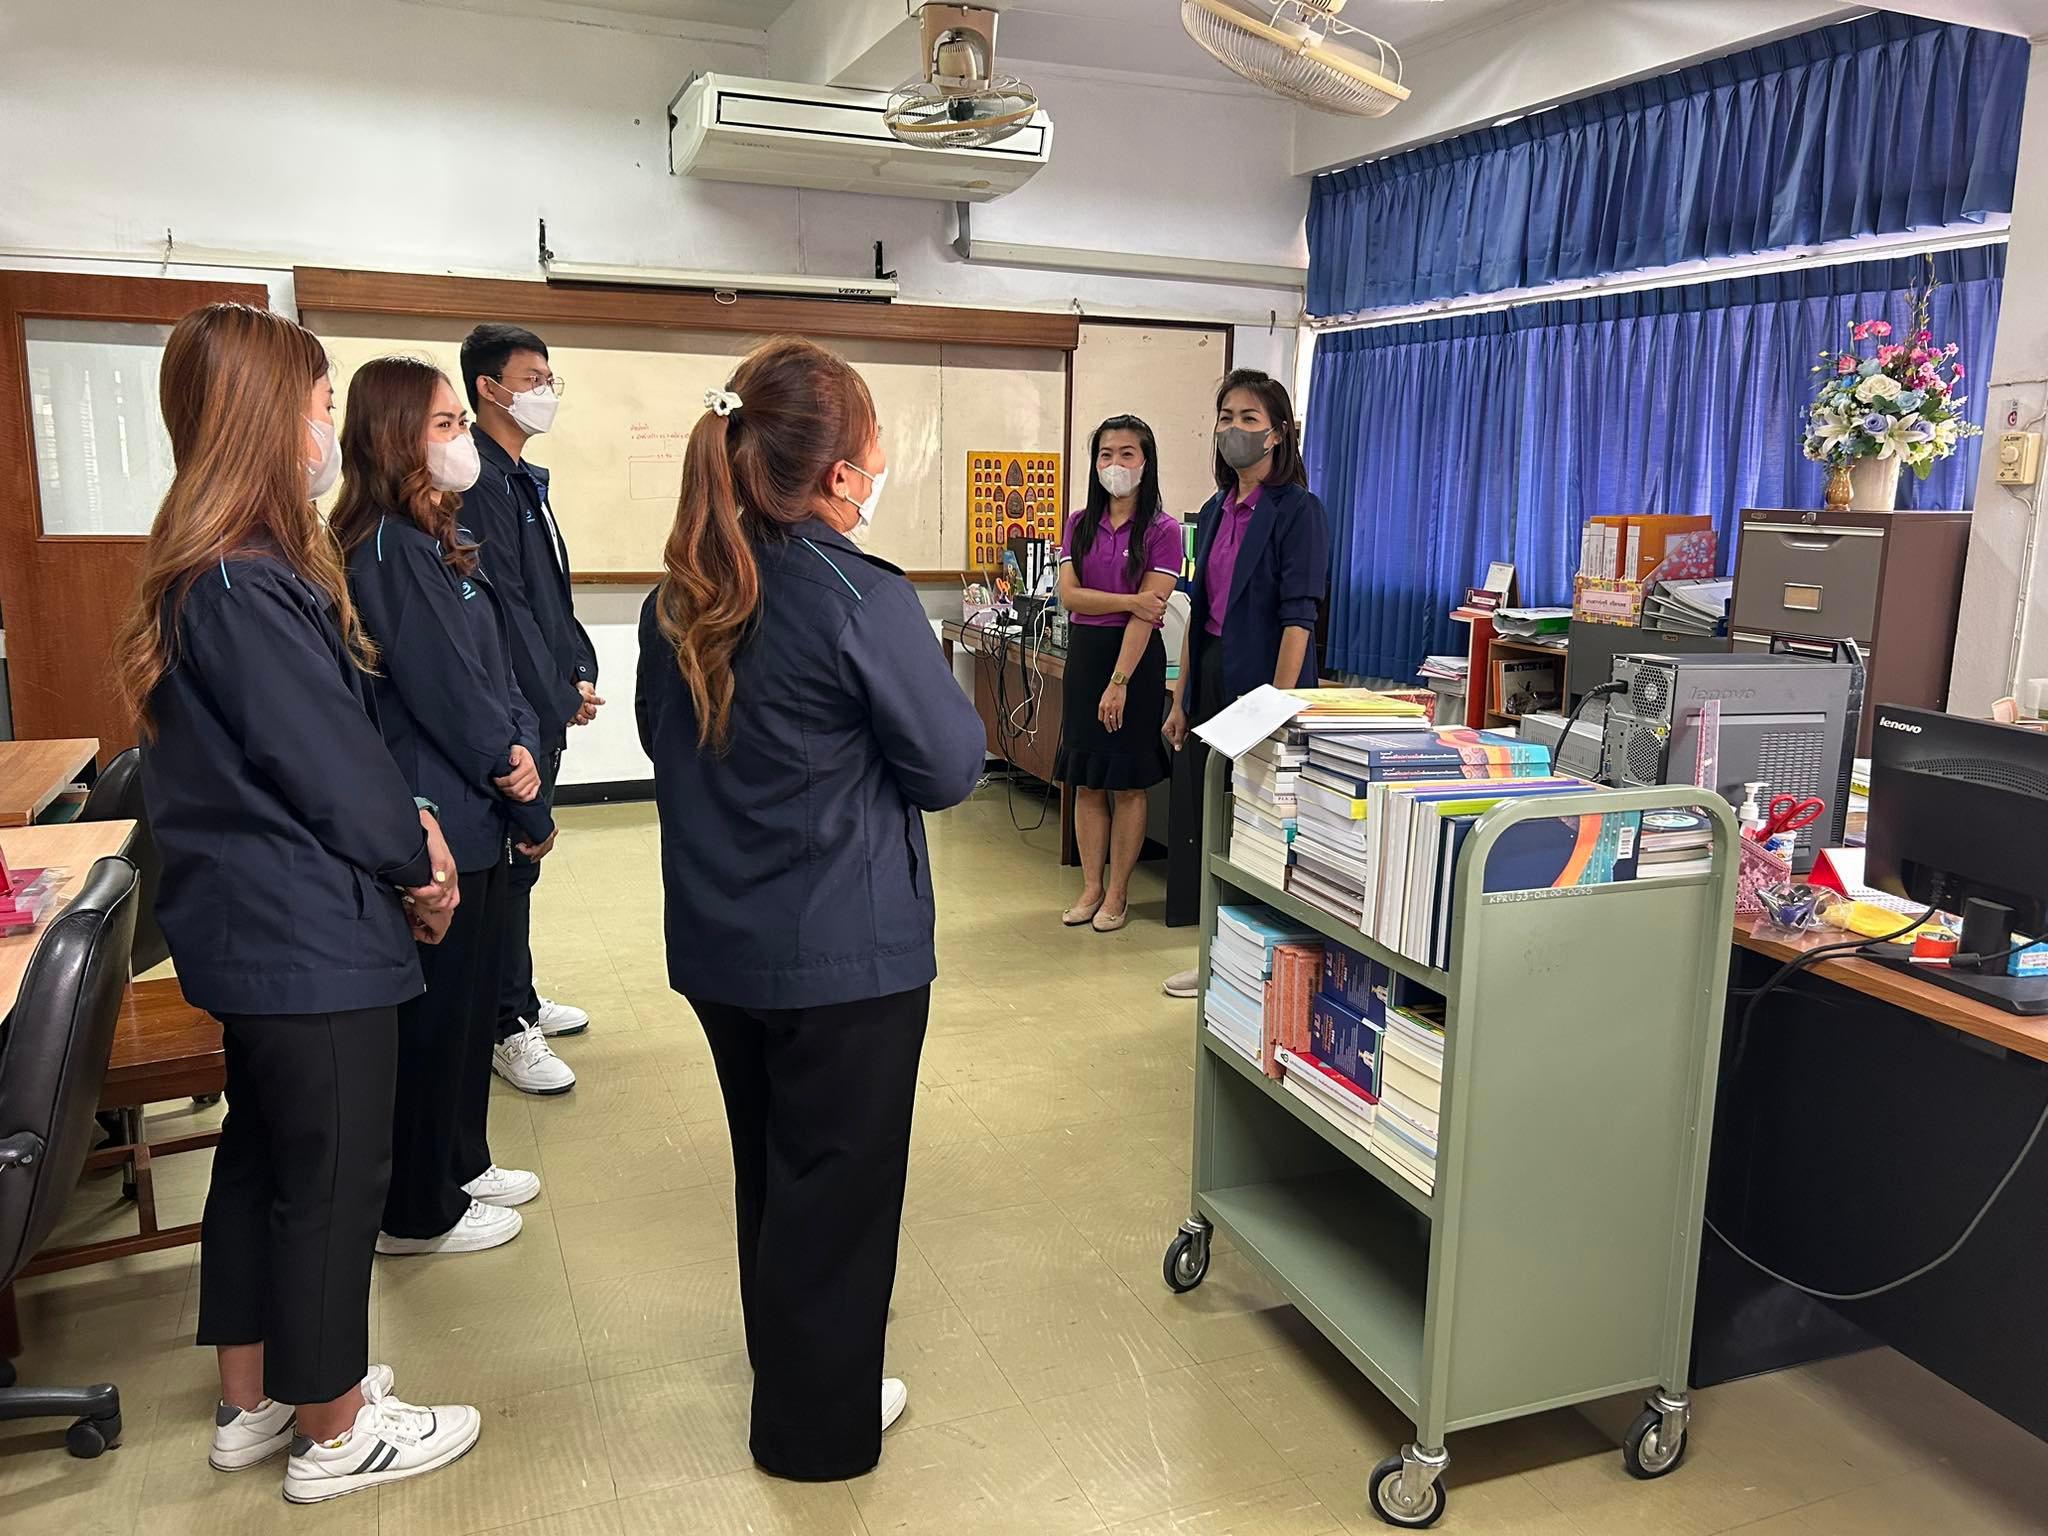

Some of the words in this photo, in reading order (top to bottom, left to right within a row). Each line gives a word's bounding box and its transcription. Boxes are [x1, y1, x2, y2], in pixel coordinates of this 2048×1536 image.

[838, 287, 873, 295] VERTEX
[1689, 685, 1757, 701] lenovo
[1879, 716, 1922, 734] lenovo
